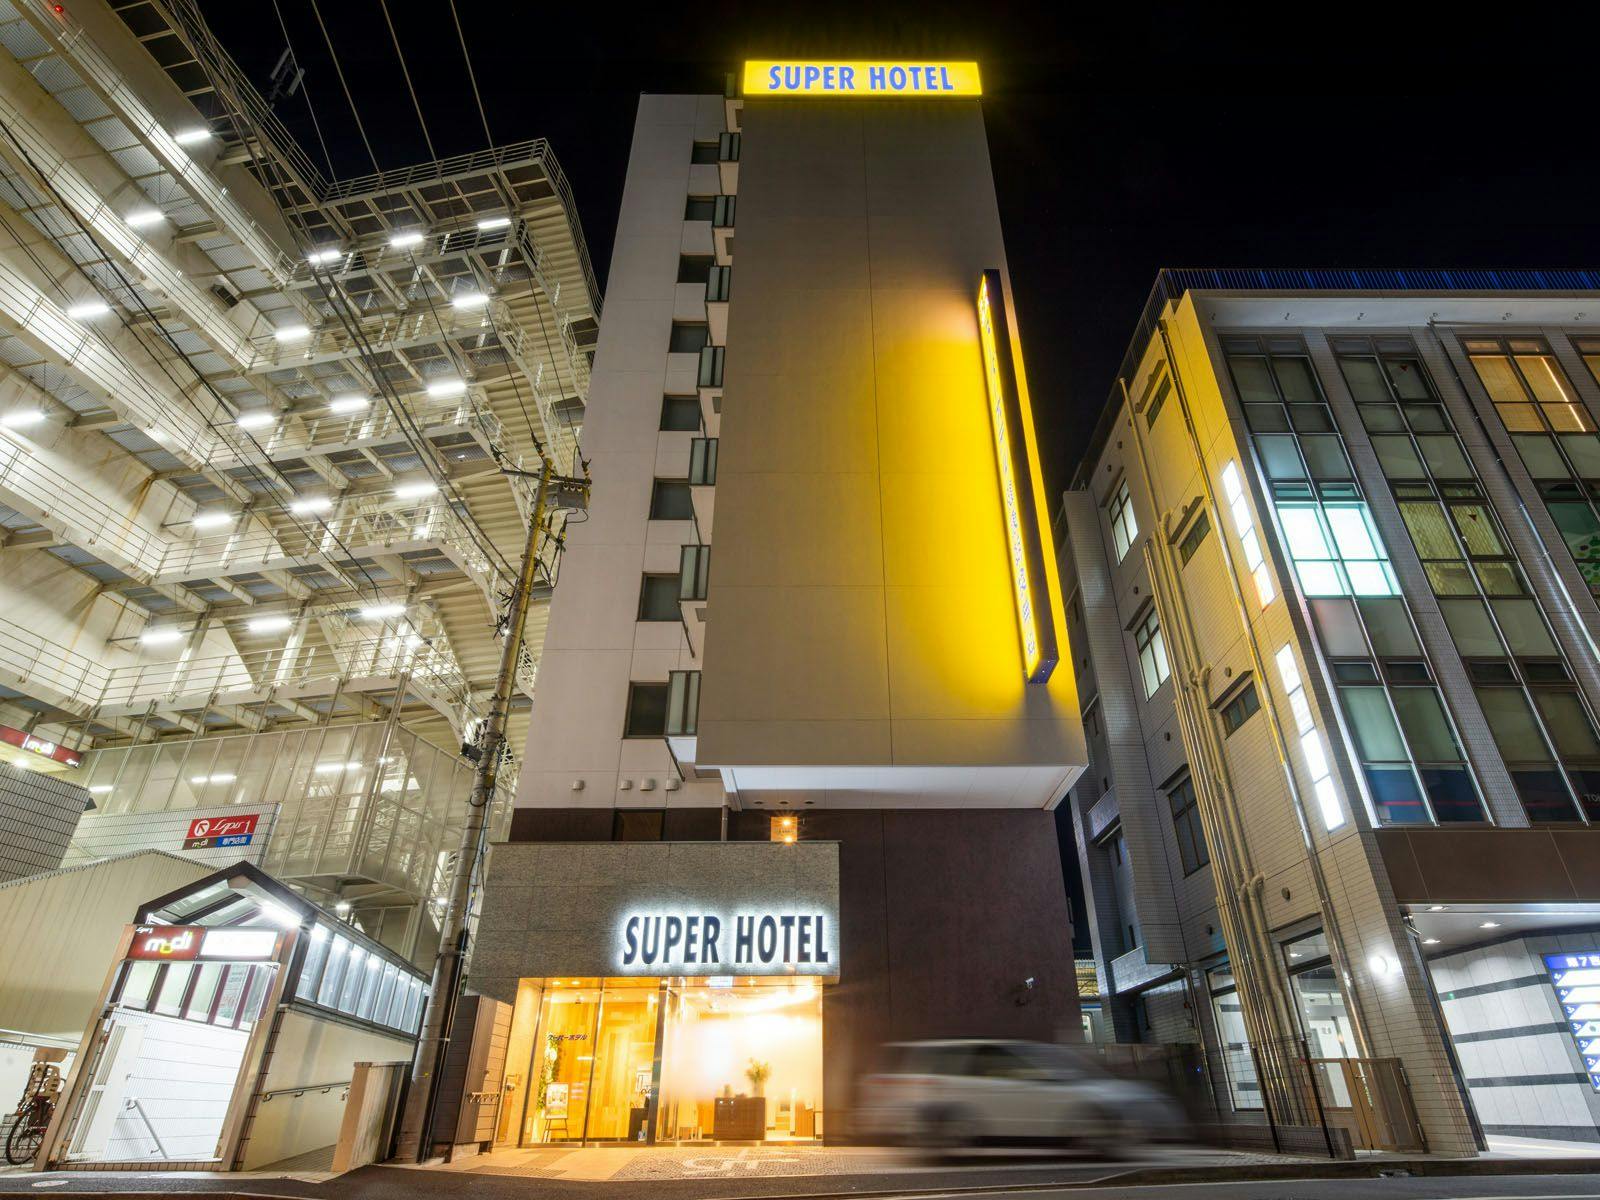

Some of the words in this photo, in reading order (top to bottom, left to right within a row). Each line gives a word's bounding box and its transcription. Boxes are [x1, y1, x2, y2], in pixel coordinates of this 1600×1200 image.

[768, 65, 855, 90] SUPER
[869, 66, 954, 91] HOTEL
[144, 930, 194, 954] modi
[622, 915, 721, 966] SUPER
[735, 915, 829, 963] HOTEL
